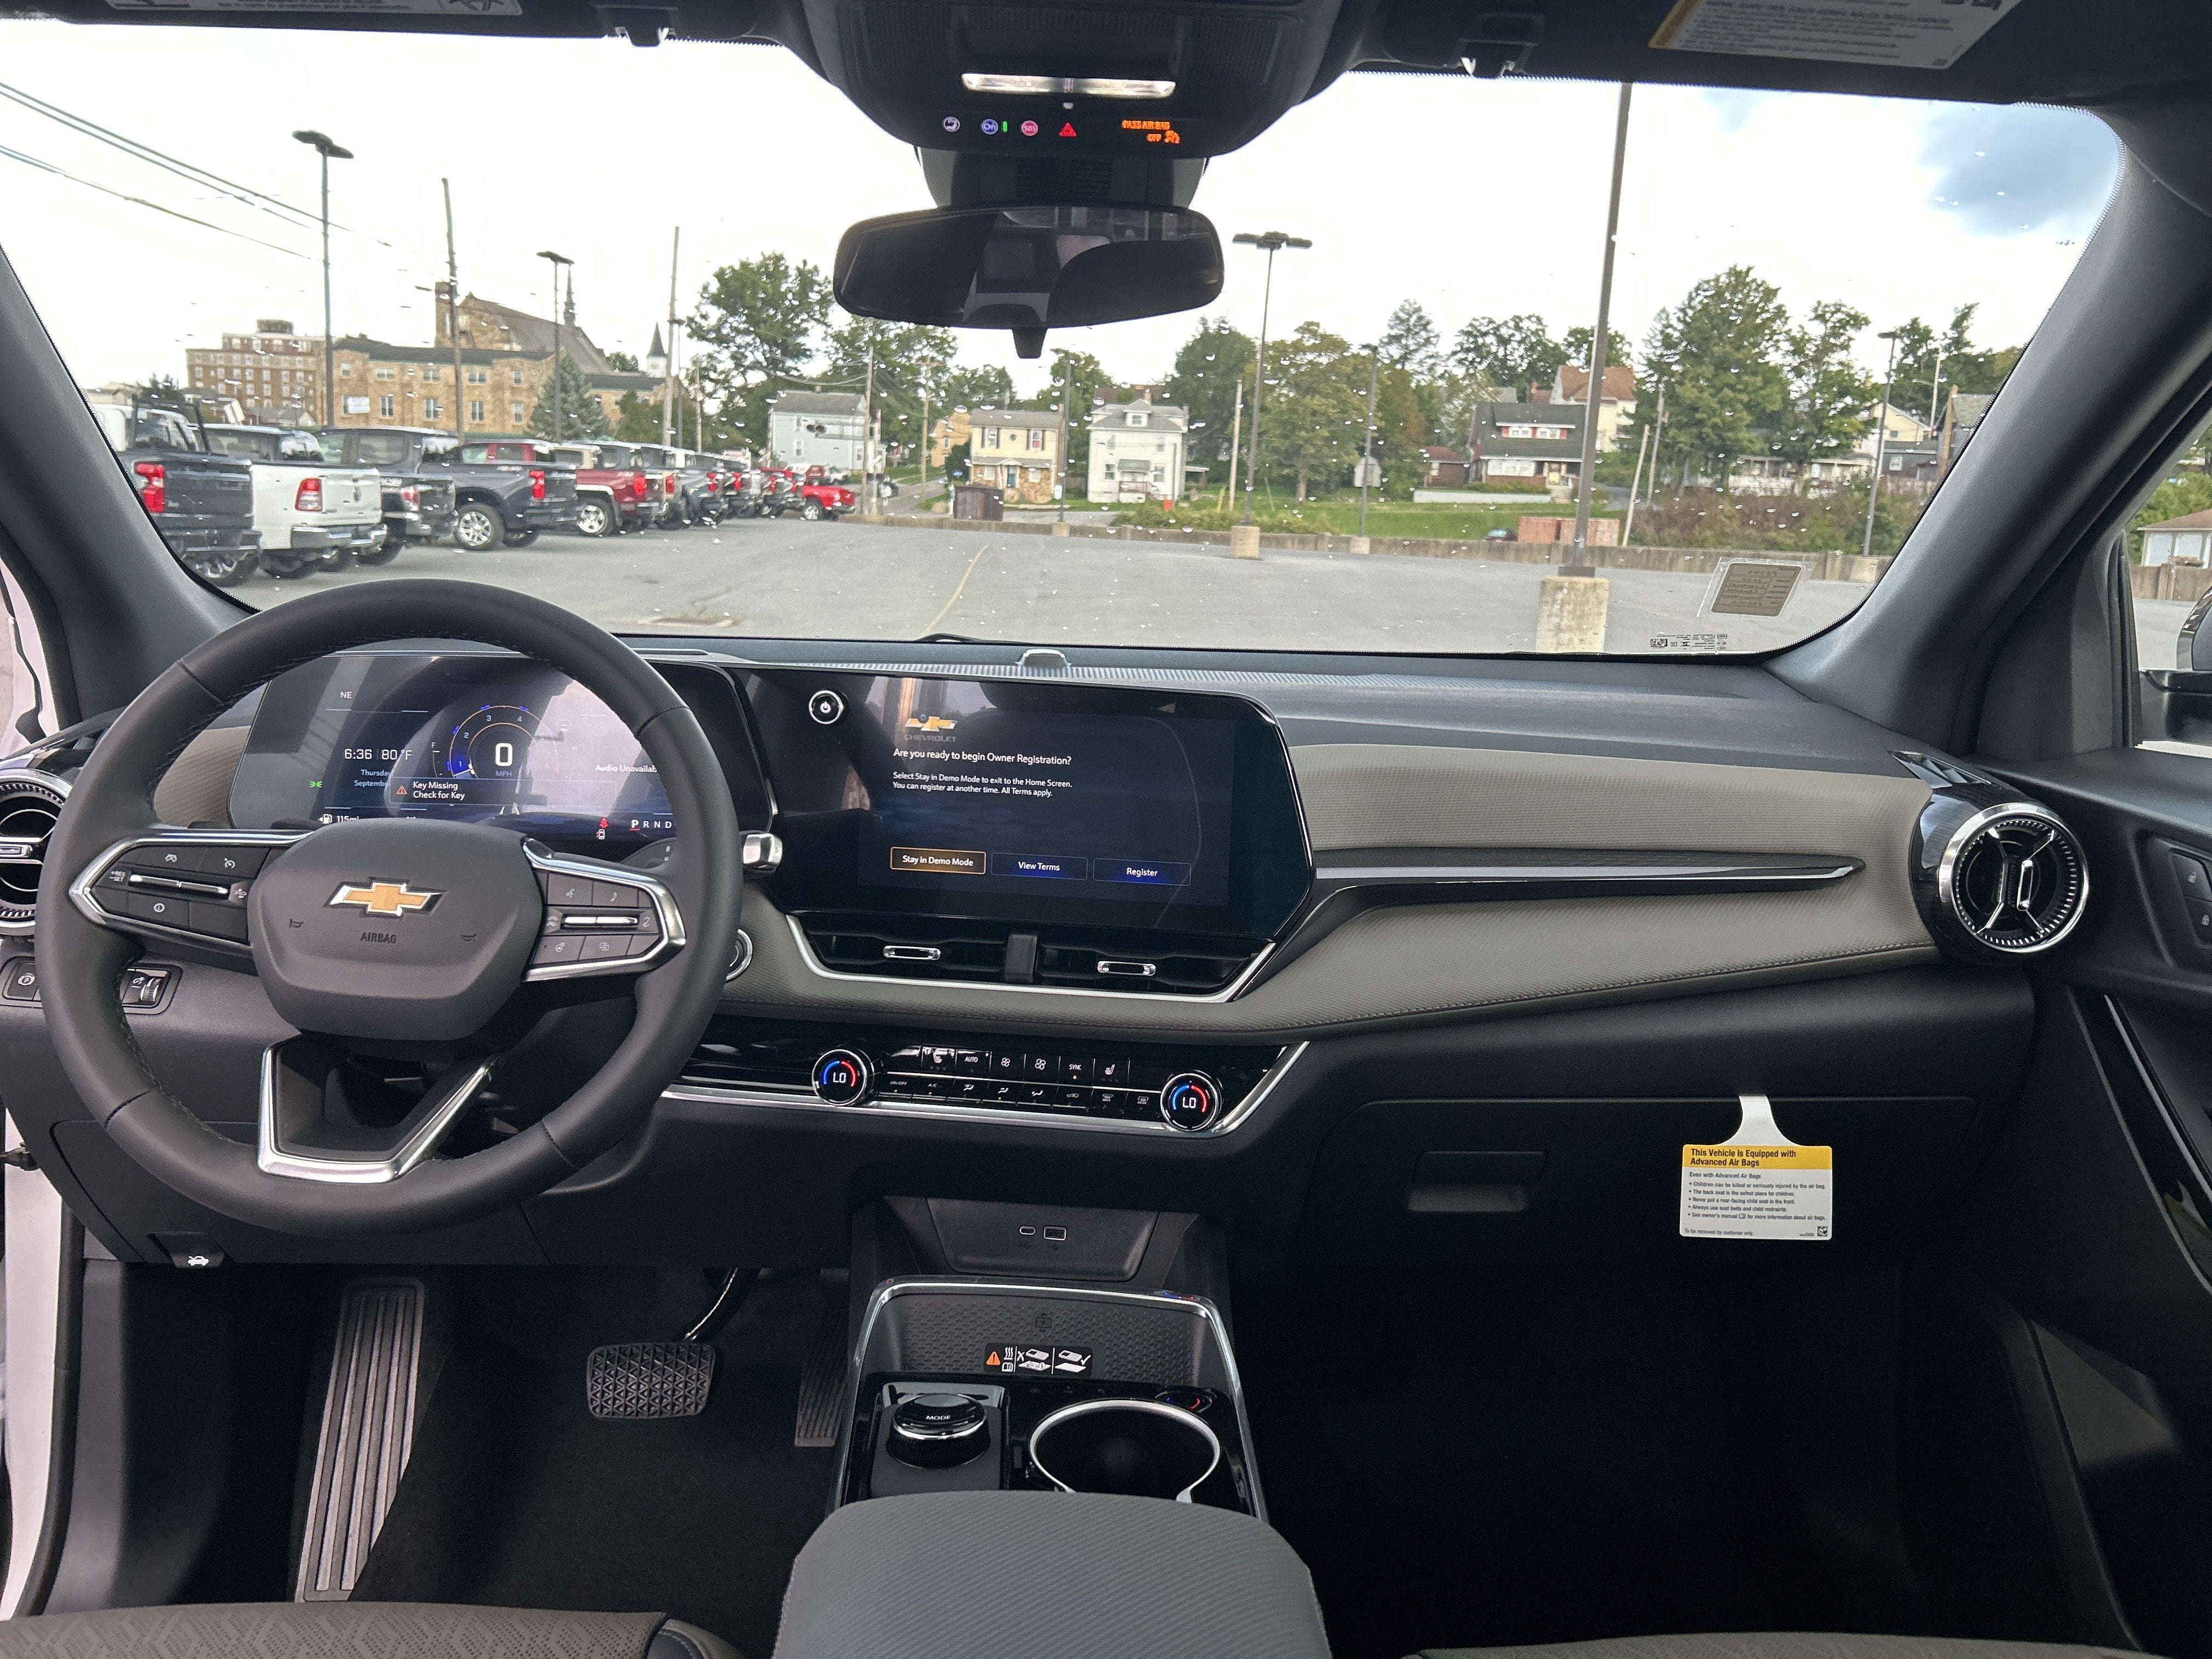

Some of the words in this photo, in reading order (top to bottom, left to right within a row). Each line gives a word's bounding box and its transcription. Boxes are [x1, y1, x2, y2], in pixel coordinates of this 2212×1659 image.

[1147, 133, 1162, 142] OFF
[905, 734, 957, 742] CHEVROLET
[345, 748, 373, 759] 6:36
[381, 749, 398, 760] 80
[495, 743, 514, 766] 0
[893, 748, 909, 758] Are
[910, 751, 926, 761] you
[927, 750, 950, 761] ready
[962, 752, 985, 764] begin
[987, 753, 1015, 763] Owner
[1017, 754, 1071, 765] Registration?
[893, 772, 914, 780] Select
[916, 773, 930, 782] Stay
[961, 775, 980, 783] Mode
[990, 776, 1002, 785] exit
[1013, 777, 1024, 786] the
[1025, 778, 1046, 787] Home
[1047, 780, 1073, 788] Screen.
[413, 781, 427, 790] Key
[428, 781, 458, 791] Missing
[893, 782, 905, 790] You
[920, 783, 945, 792] register
[955, 785, 981, 793] another
[983, 786, 1000, 794] time.
[1033, 789, 1053, 798] apply.
[413, 791, 437, 799] Check
[438, 791, 450, 799] for
[451, 791, 465, 801] Key
[631, 819, 639, 828] P
[902, 855, 919, 866] Stay
[920, 856, 927, 864] in
[928, 856, 951, 865] Demo
[952, 858, 974, 866] Mode
[1018, 861, 1036, 870] View
[1037, 862, 1060, 871] Terms
[1126, 867, 1158, 877] Register
[360, 932, 397, 944] AIRBAG
[833, 1072, 847, 1083] LO
[1182, 1097, 1197, 1108] LO
[1691, 1148, 1707, 1156] This
[1708, 1149, 1735, 1158] Vehicle
[1746, 1149, 1779, 1159] Equipped
[1690, 1158, 1726, 1166] Advanced
[1741, 1159, 1759, 1167] Bags
